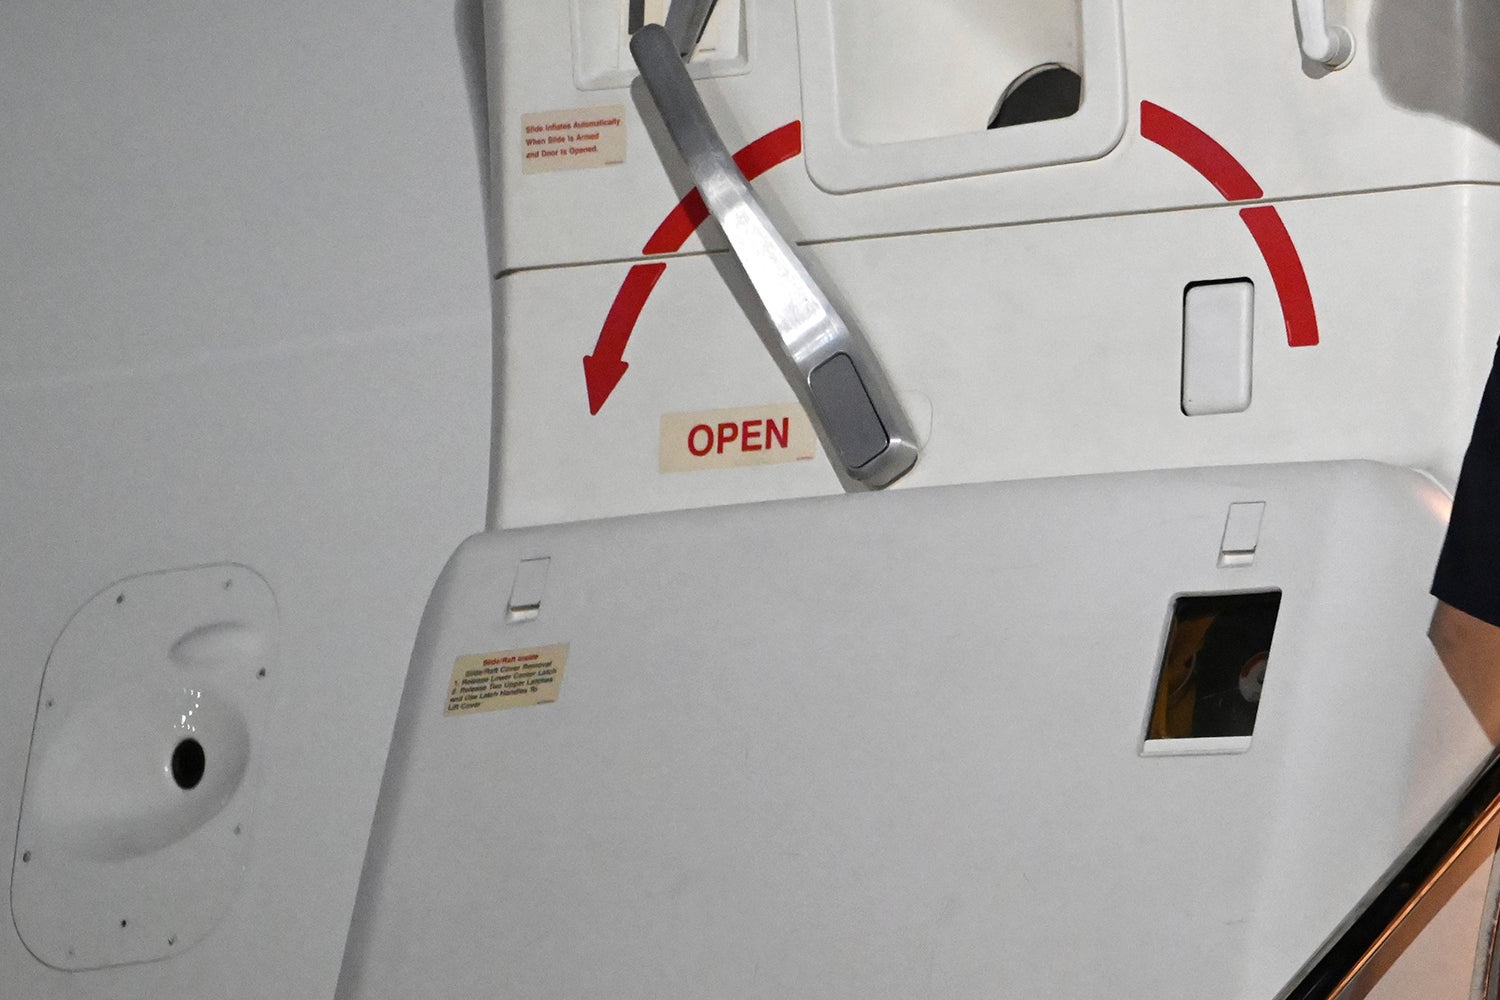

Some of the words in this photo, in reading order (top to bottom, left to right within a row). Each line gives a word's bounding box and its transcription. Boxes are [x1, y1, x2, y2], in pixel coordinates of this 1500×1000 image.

[525, 125, 543, 134] Slide
[545, 122, 572, 131] Inflates
[573, 117, 620, 129] Automatically
[526, 138, 546, 146] When
[547, 135, 565, 144] Slide
[576, 132, 600, 141] Armed
[526, 150, 539, 158] and
[541, 149, 558, 157] Door
[687, 416, 790, 457] OPEN
